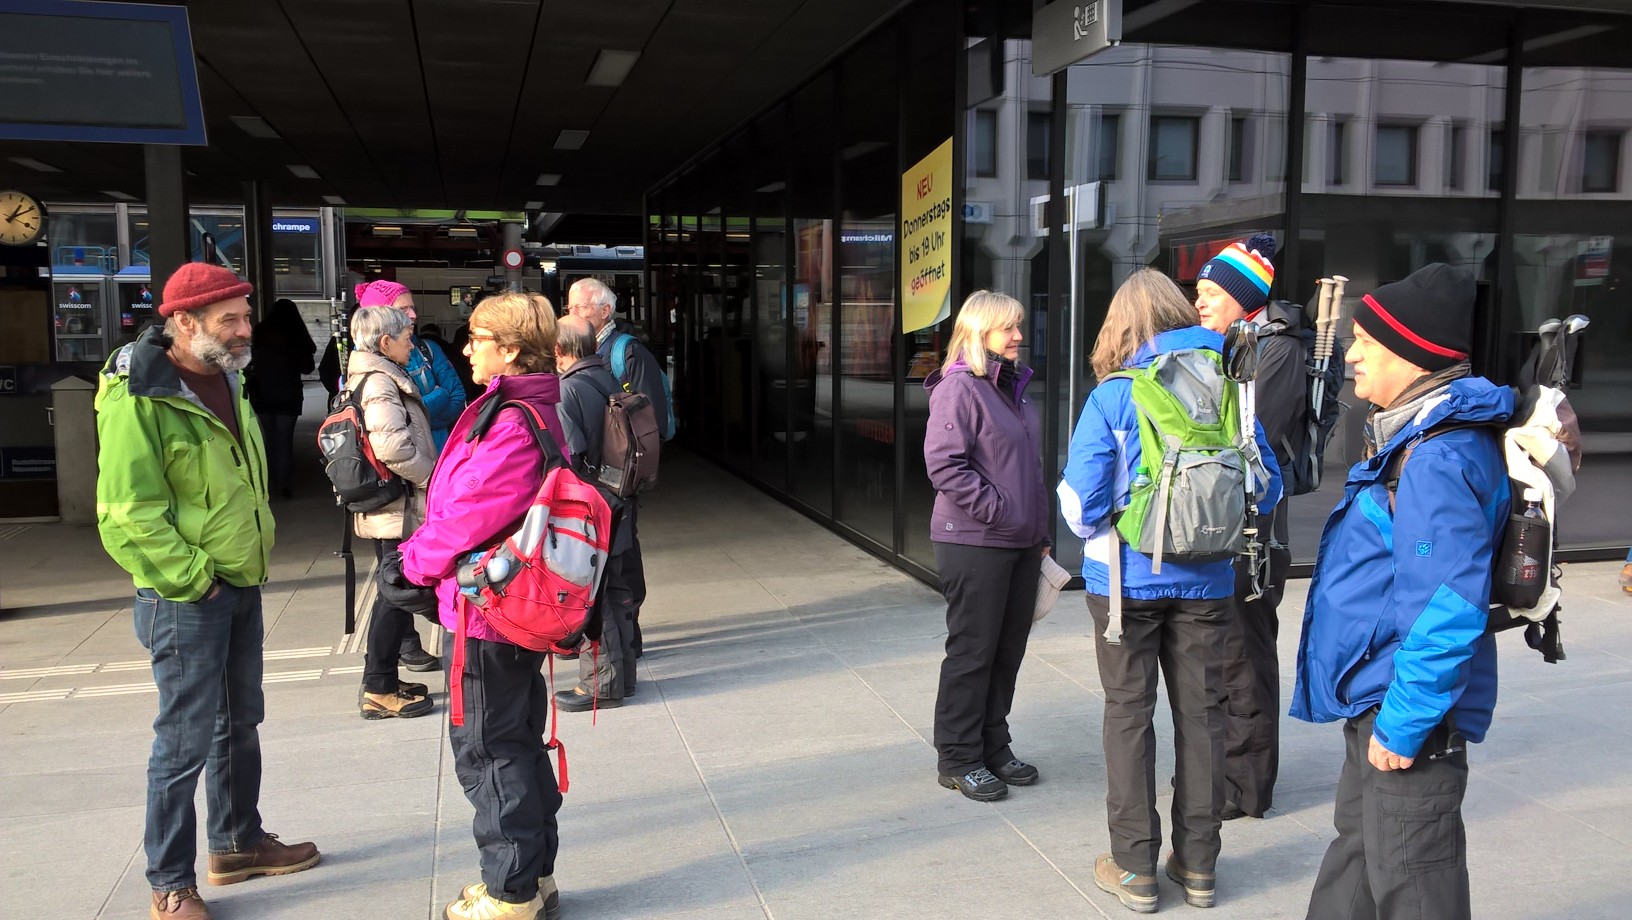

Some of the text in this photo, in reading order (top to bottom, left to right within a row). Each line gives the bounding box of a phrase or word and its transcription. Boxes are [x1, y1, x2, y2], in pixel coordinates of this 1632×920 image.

[916, 172, 933, 200] NEU
[272, 222, 311, 232] chrampe
[903, 197, 950, 239] Donnerstags
[909, 231, 946, 264] bis 19 Uhr
[911, 260, 946, 296] geöffnet
